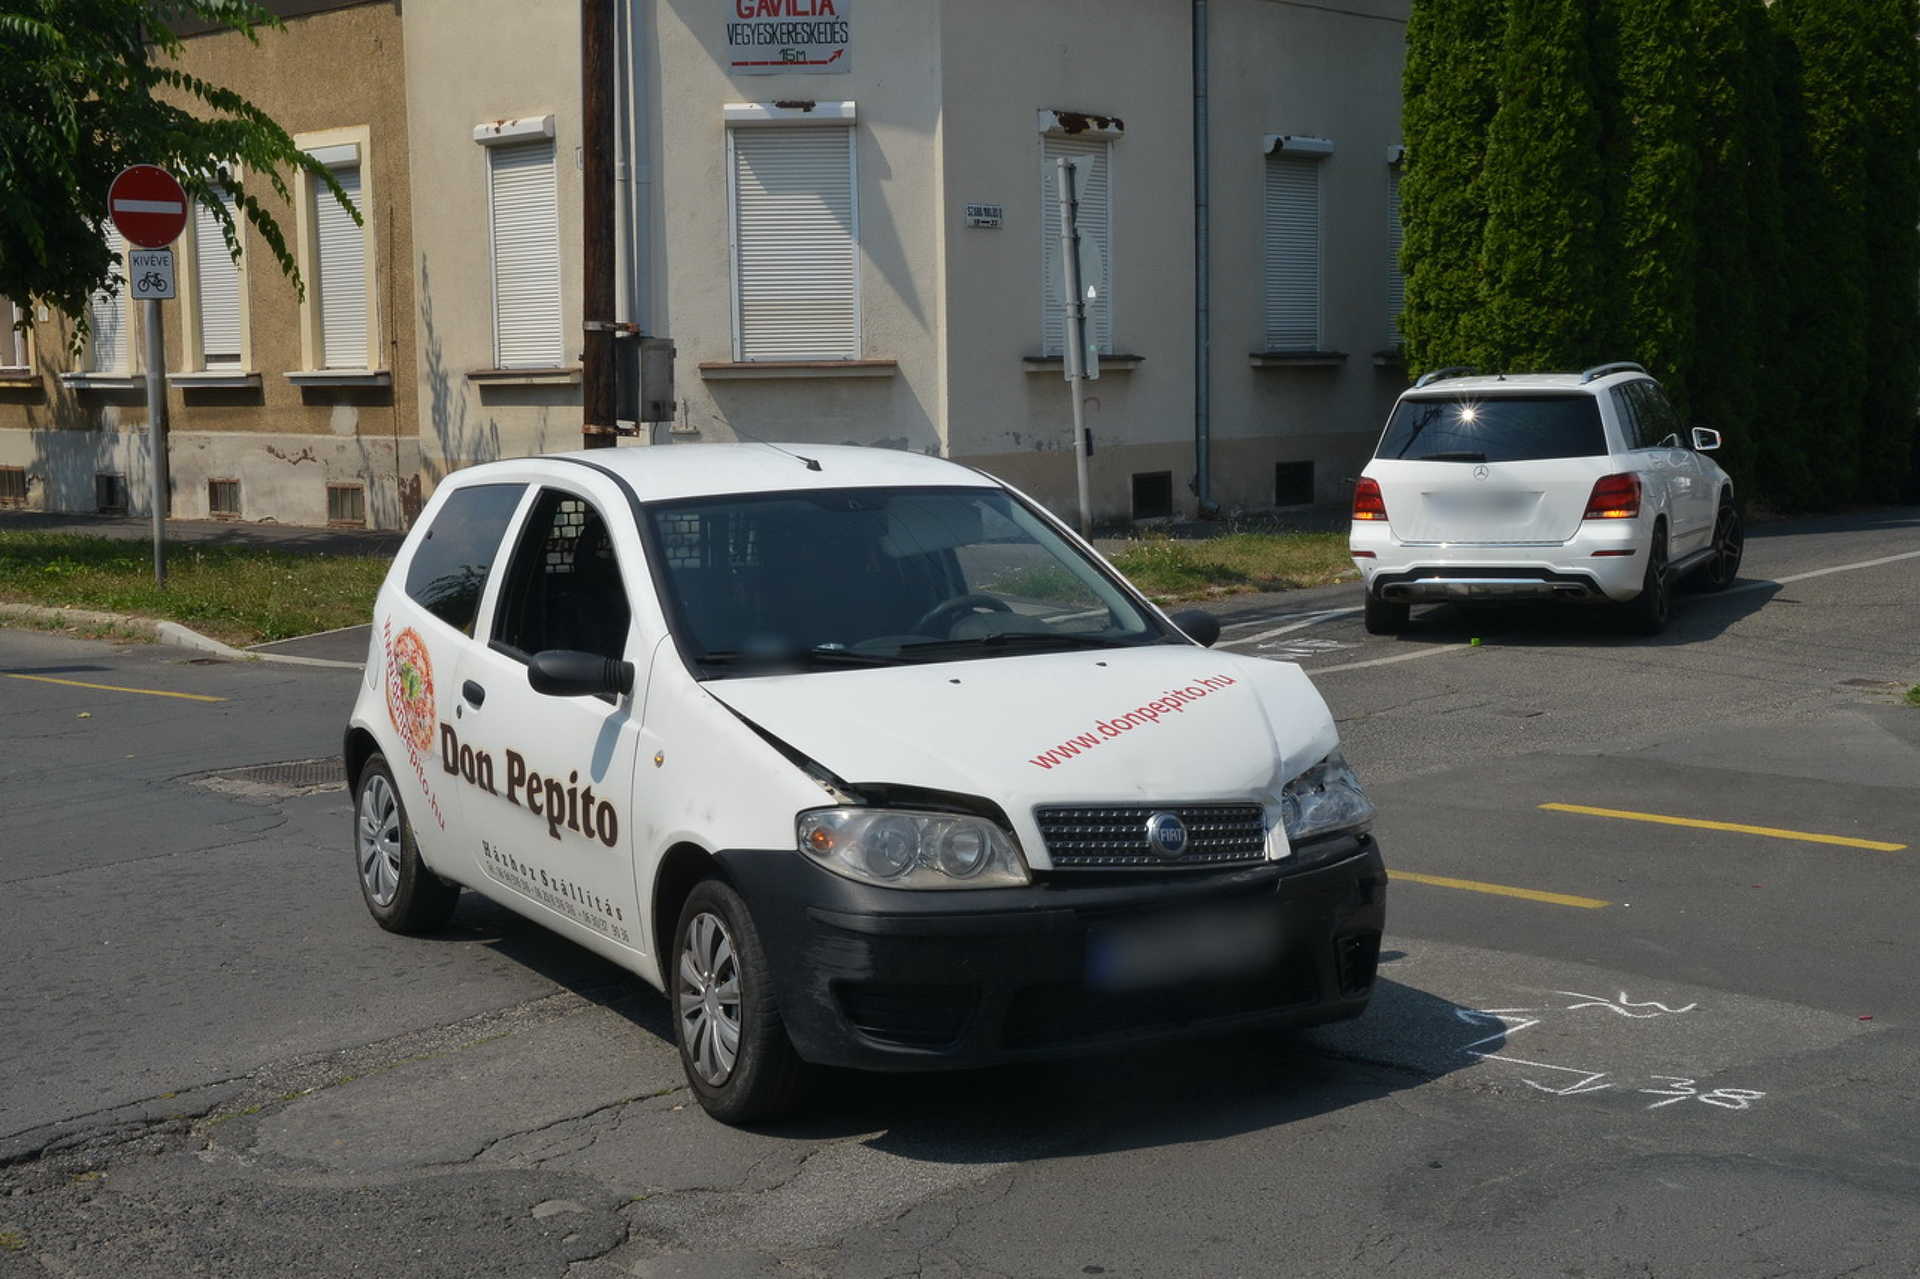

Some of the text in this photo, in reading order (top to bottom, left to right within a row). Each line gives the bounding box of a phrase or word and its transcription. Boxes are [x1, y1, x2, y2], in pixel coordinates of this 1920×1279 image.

[727, 16, 848, 45] VEGYESKERESKEDÉS
[133, 255, 169, 267] KIVÉVE
[1029, 674, 1237, 770] www.donpepito.hu
[440, 722, 618, 848] Don Pepito
[1160, 830, 1181, 841] FIAT
